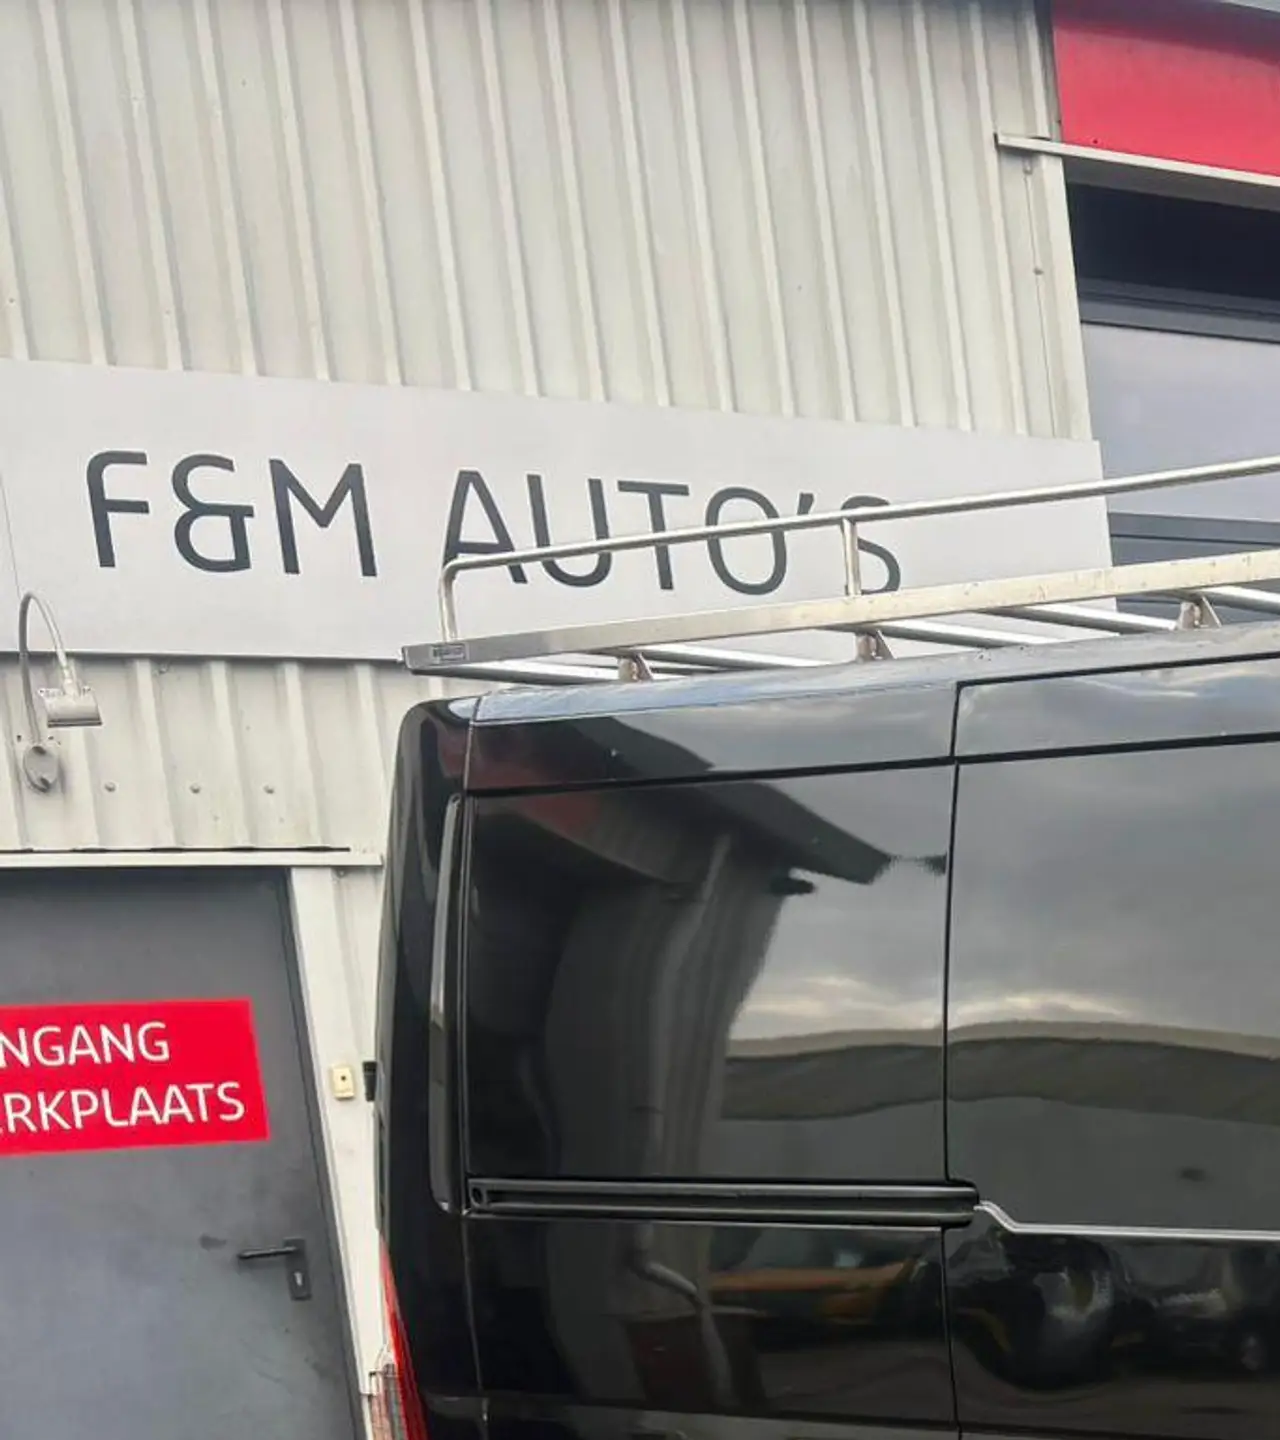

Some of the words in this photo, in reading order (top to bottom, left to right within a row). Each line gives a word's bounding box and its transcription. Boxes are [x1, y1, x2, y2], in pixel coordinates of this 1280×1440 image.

[84, 450, 378, 577] F&M
[443, 469, 902, 596] AUTO'S
[0, 1081, 246, 1134] RKPLAATS
